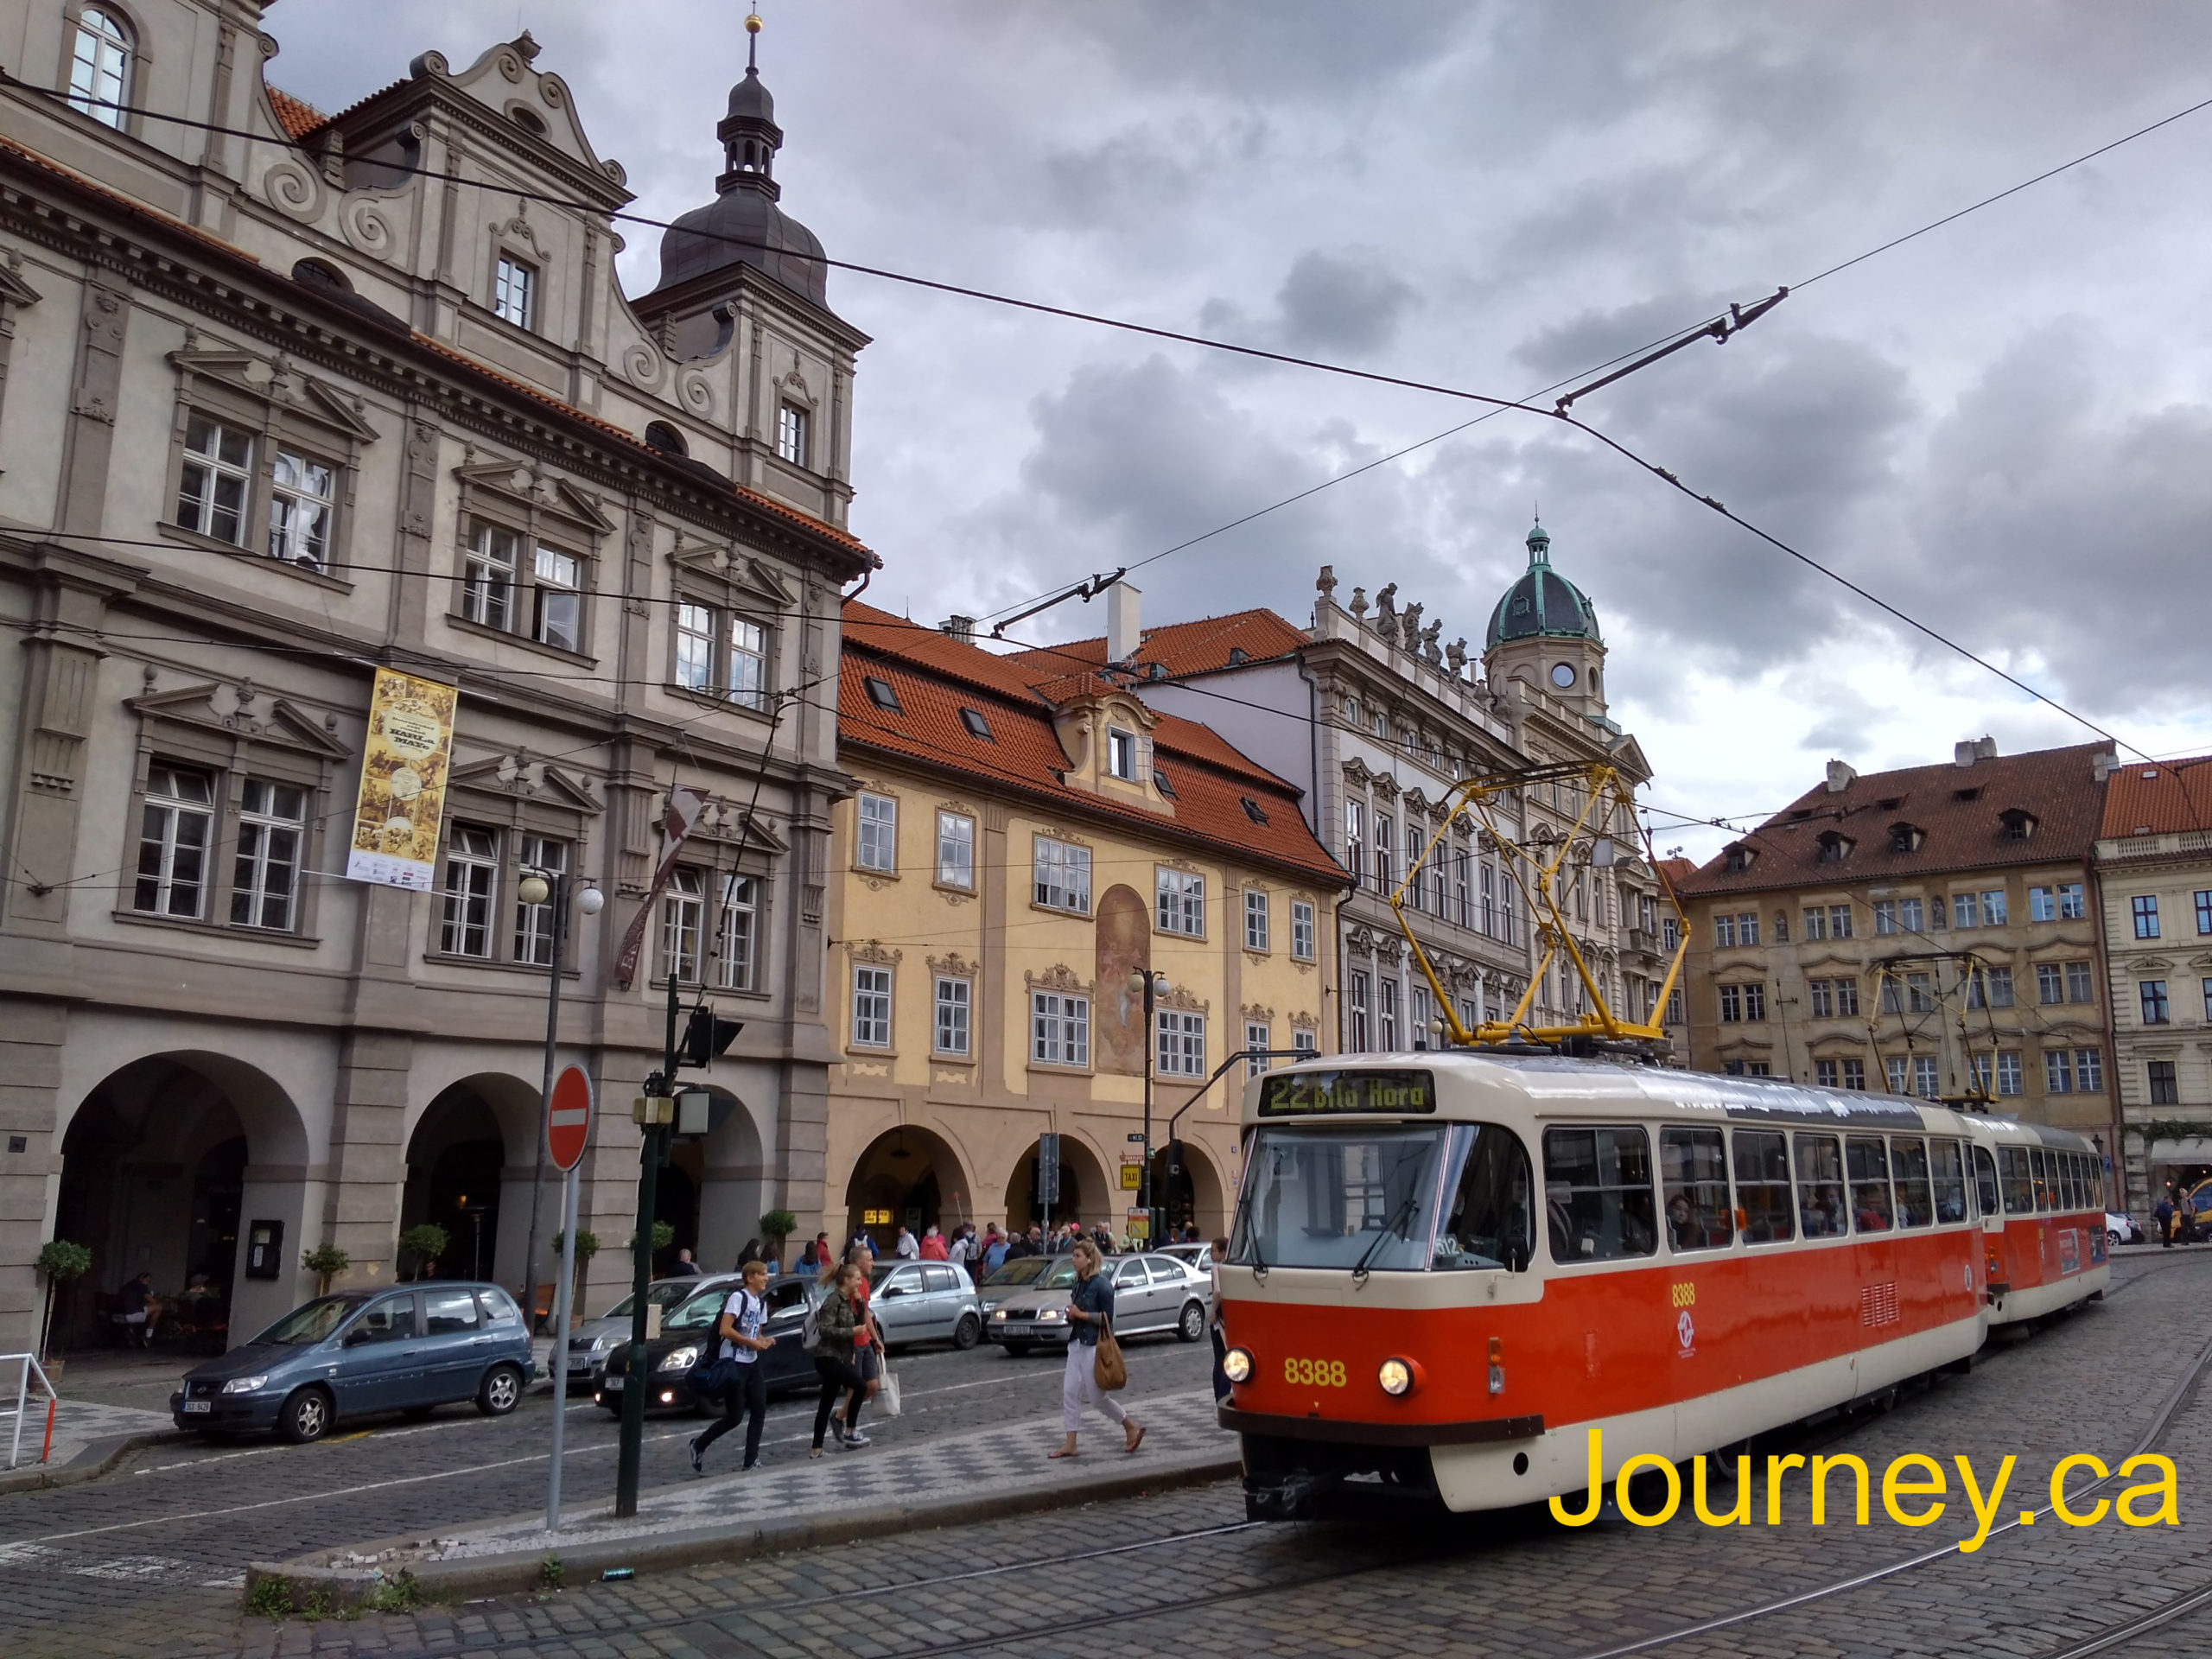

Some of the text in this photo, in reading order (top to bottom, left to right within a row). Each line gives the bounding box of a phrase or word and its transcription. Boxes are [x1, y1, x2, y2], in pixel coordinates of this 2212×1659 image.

[1271, 1077, 1308, 1109] 22
[1370, 1079, 1424, 1107] Hora
[1125, 1173, 1137, 1182] TAXI
[1673, 1282, 1694, 1307] 8388
[1284, 1357, 1347, 1388] 8388
